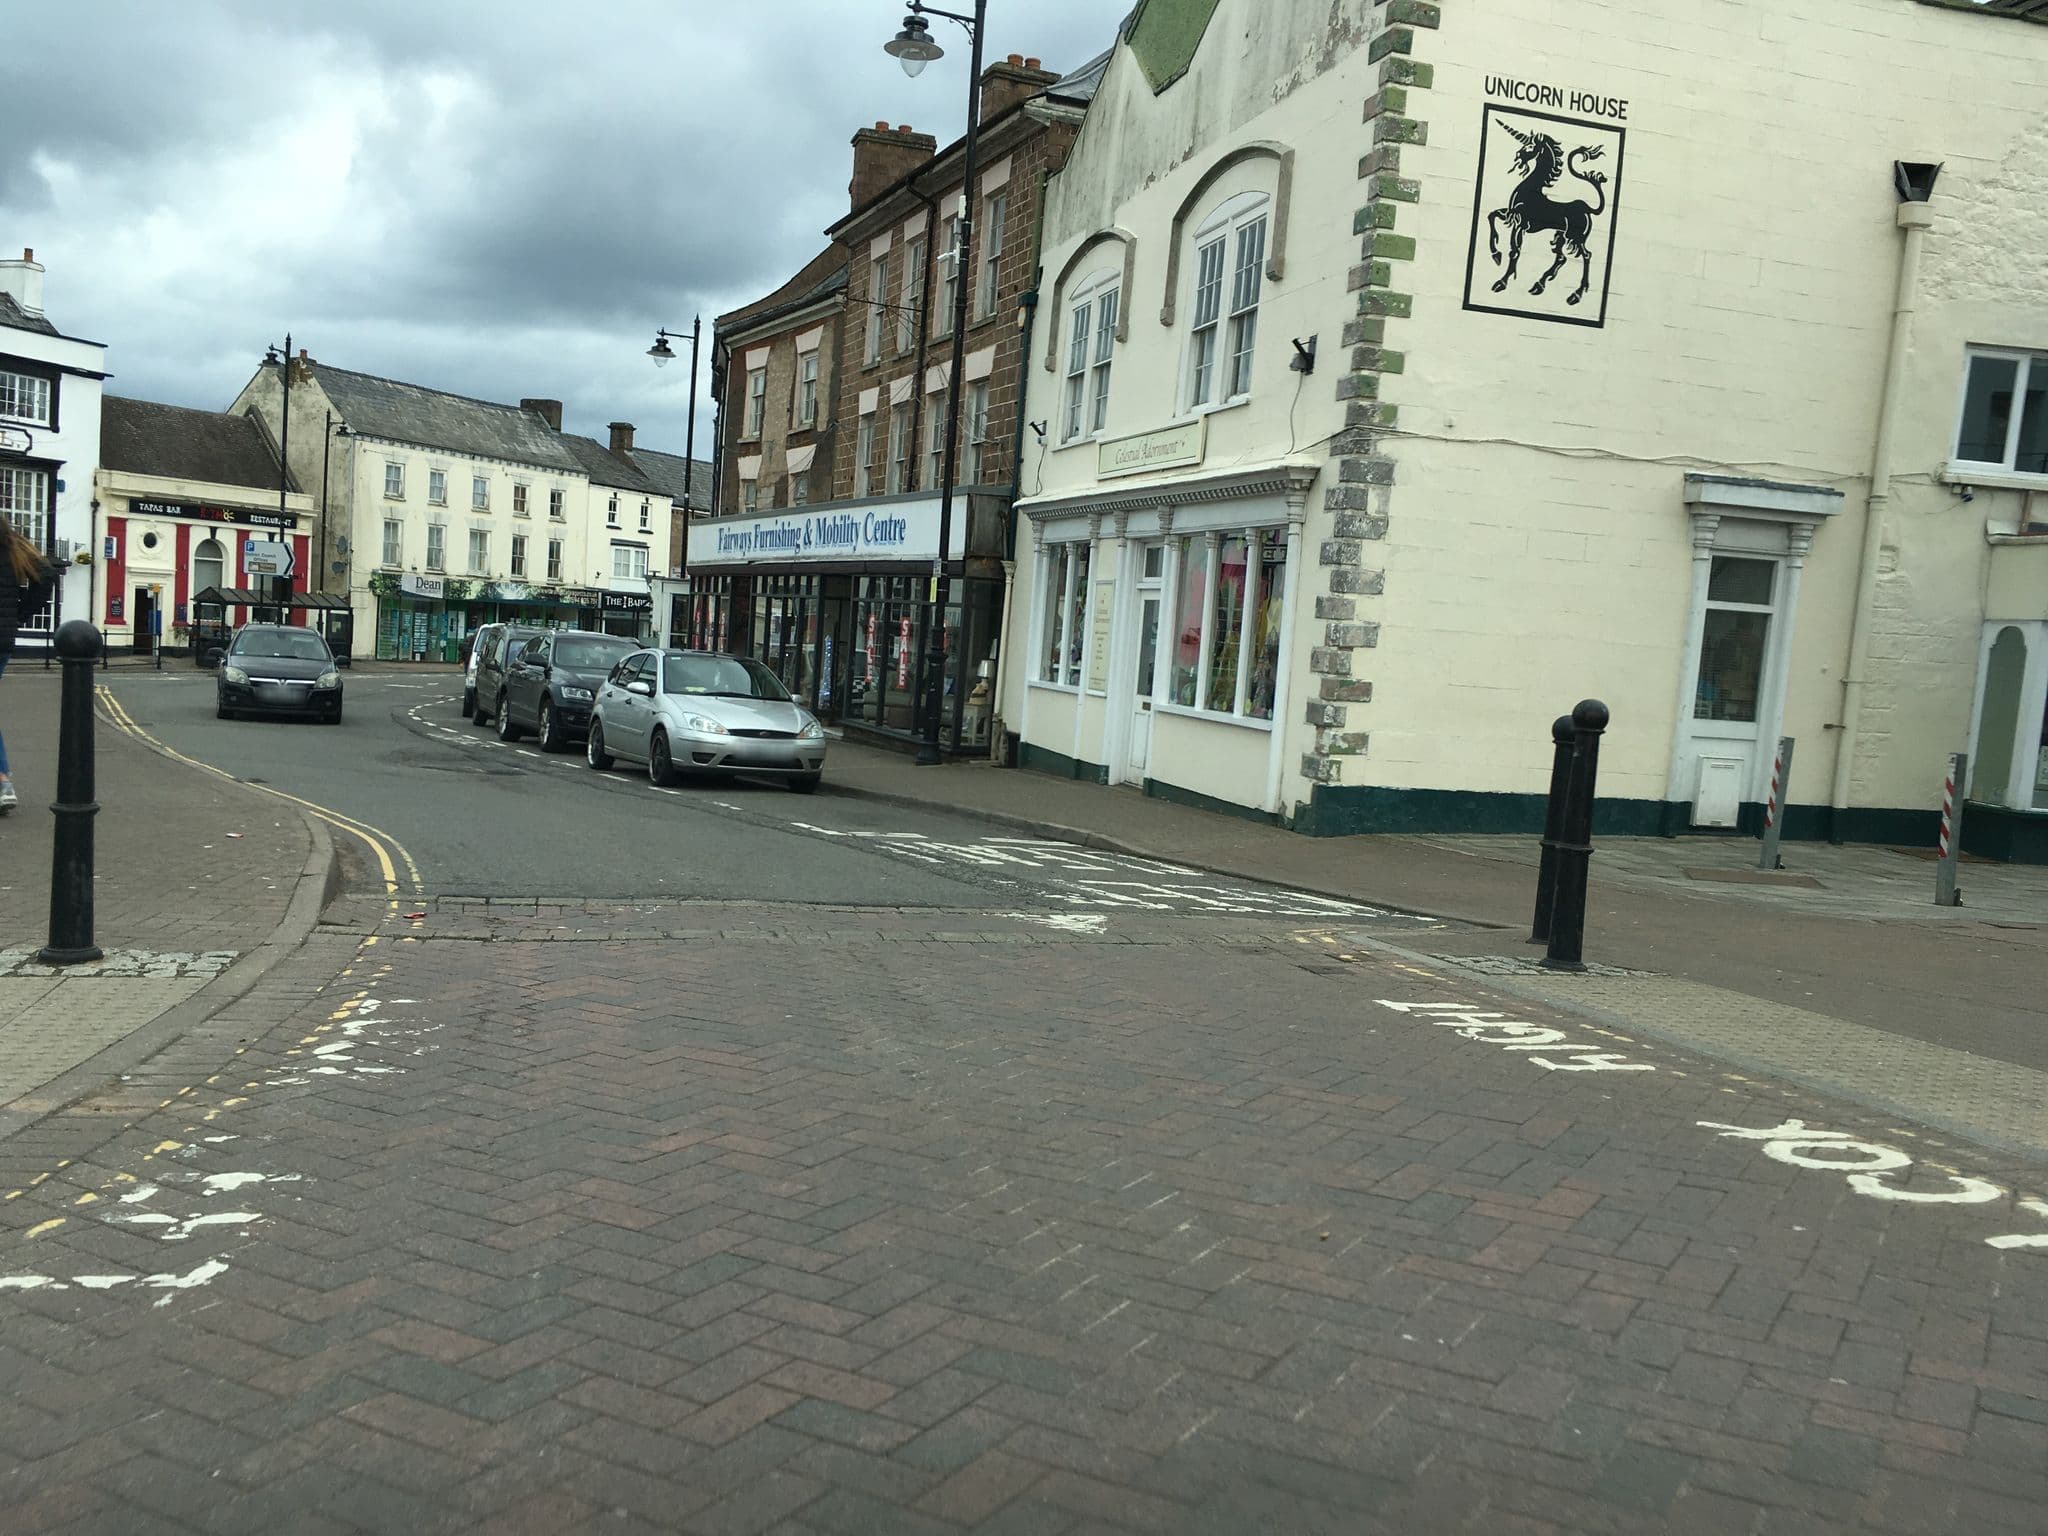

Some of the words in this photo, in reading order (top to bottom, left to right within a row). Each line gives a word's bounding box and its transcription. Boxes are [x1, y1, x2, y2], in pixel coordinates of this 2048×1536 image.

[1485, 75, 1563, 108] UNICORN
[1570, 91, 1629, 120] HOUSE
[138, 503, 163, 513] TAPAS
[166, 505, 182, 514] BAR
[249, 514, 292, 527] RESTAURNT
[718, 526, 752, 557] Fairways
[754, 519, 801, 554] Furnishing
[803, 518, 813, 546] &
[815, 514, 861, 552] Mobility
[863, 511, 906, 544] Centre
[415, 576, 441, 590] Dean
[605, 595, 622, 606] THE
[867, 616, 875, 680] SALE
[899, 620, 909, 686] SALE
[1373, 999, 1655, 1071] RIGHT
